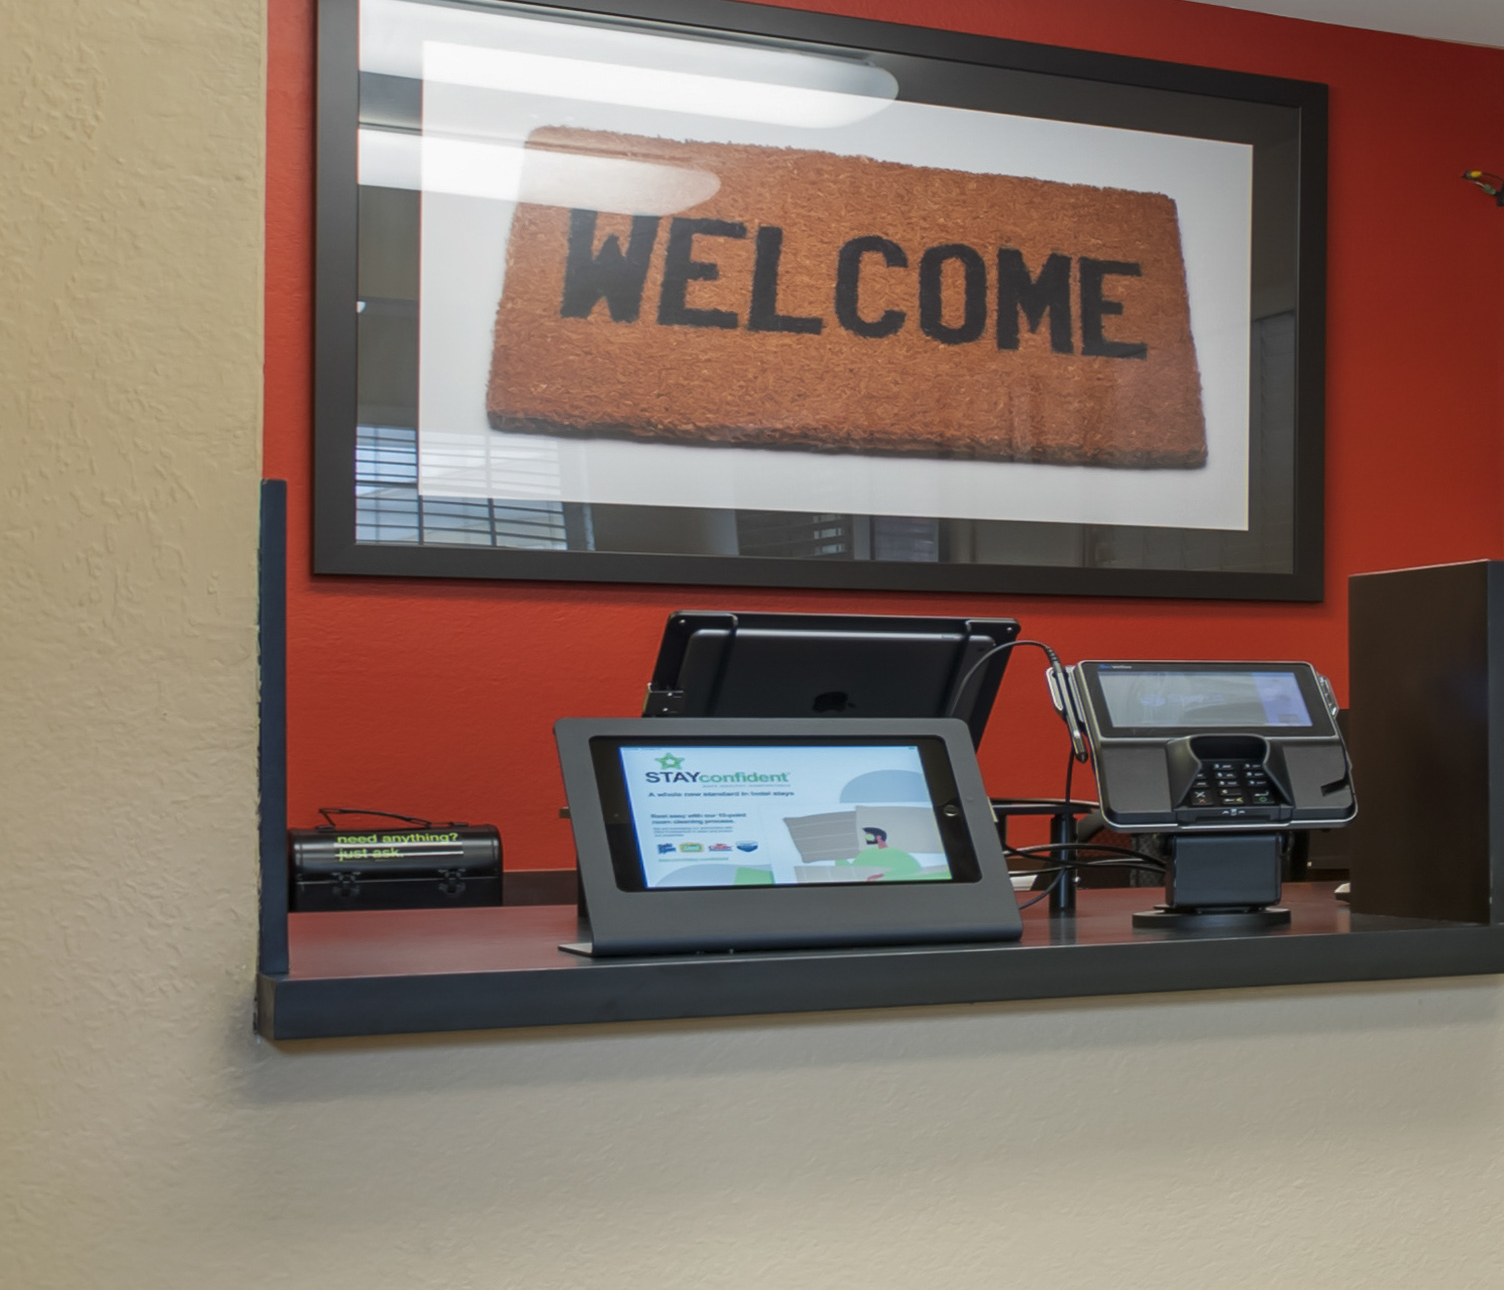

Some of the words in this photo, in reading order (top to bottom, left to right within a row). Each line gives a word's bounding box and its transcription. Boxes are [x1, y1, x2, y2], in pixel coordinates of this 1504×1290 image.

[560, 209, 1148, 360] WELCOME
[337, 834, 378, 843] need
[382, 832, 459, 844] anything?
[338, 847, 369, 861] just
